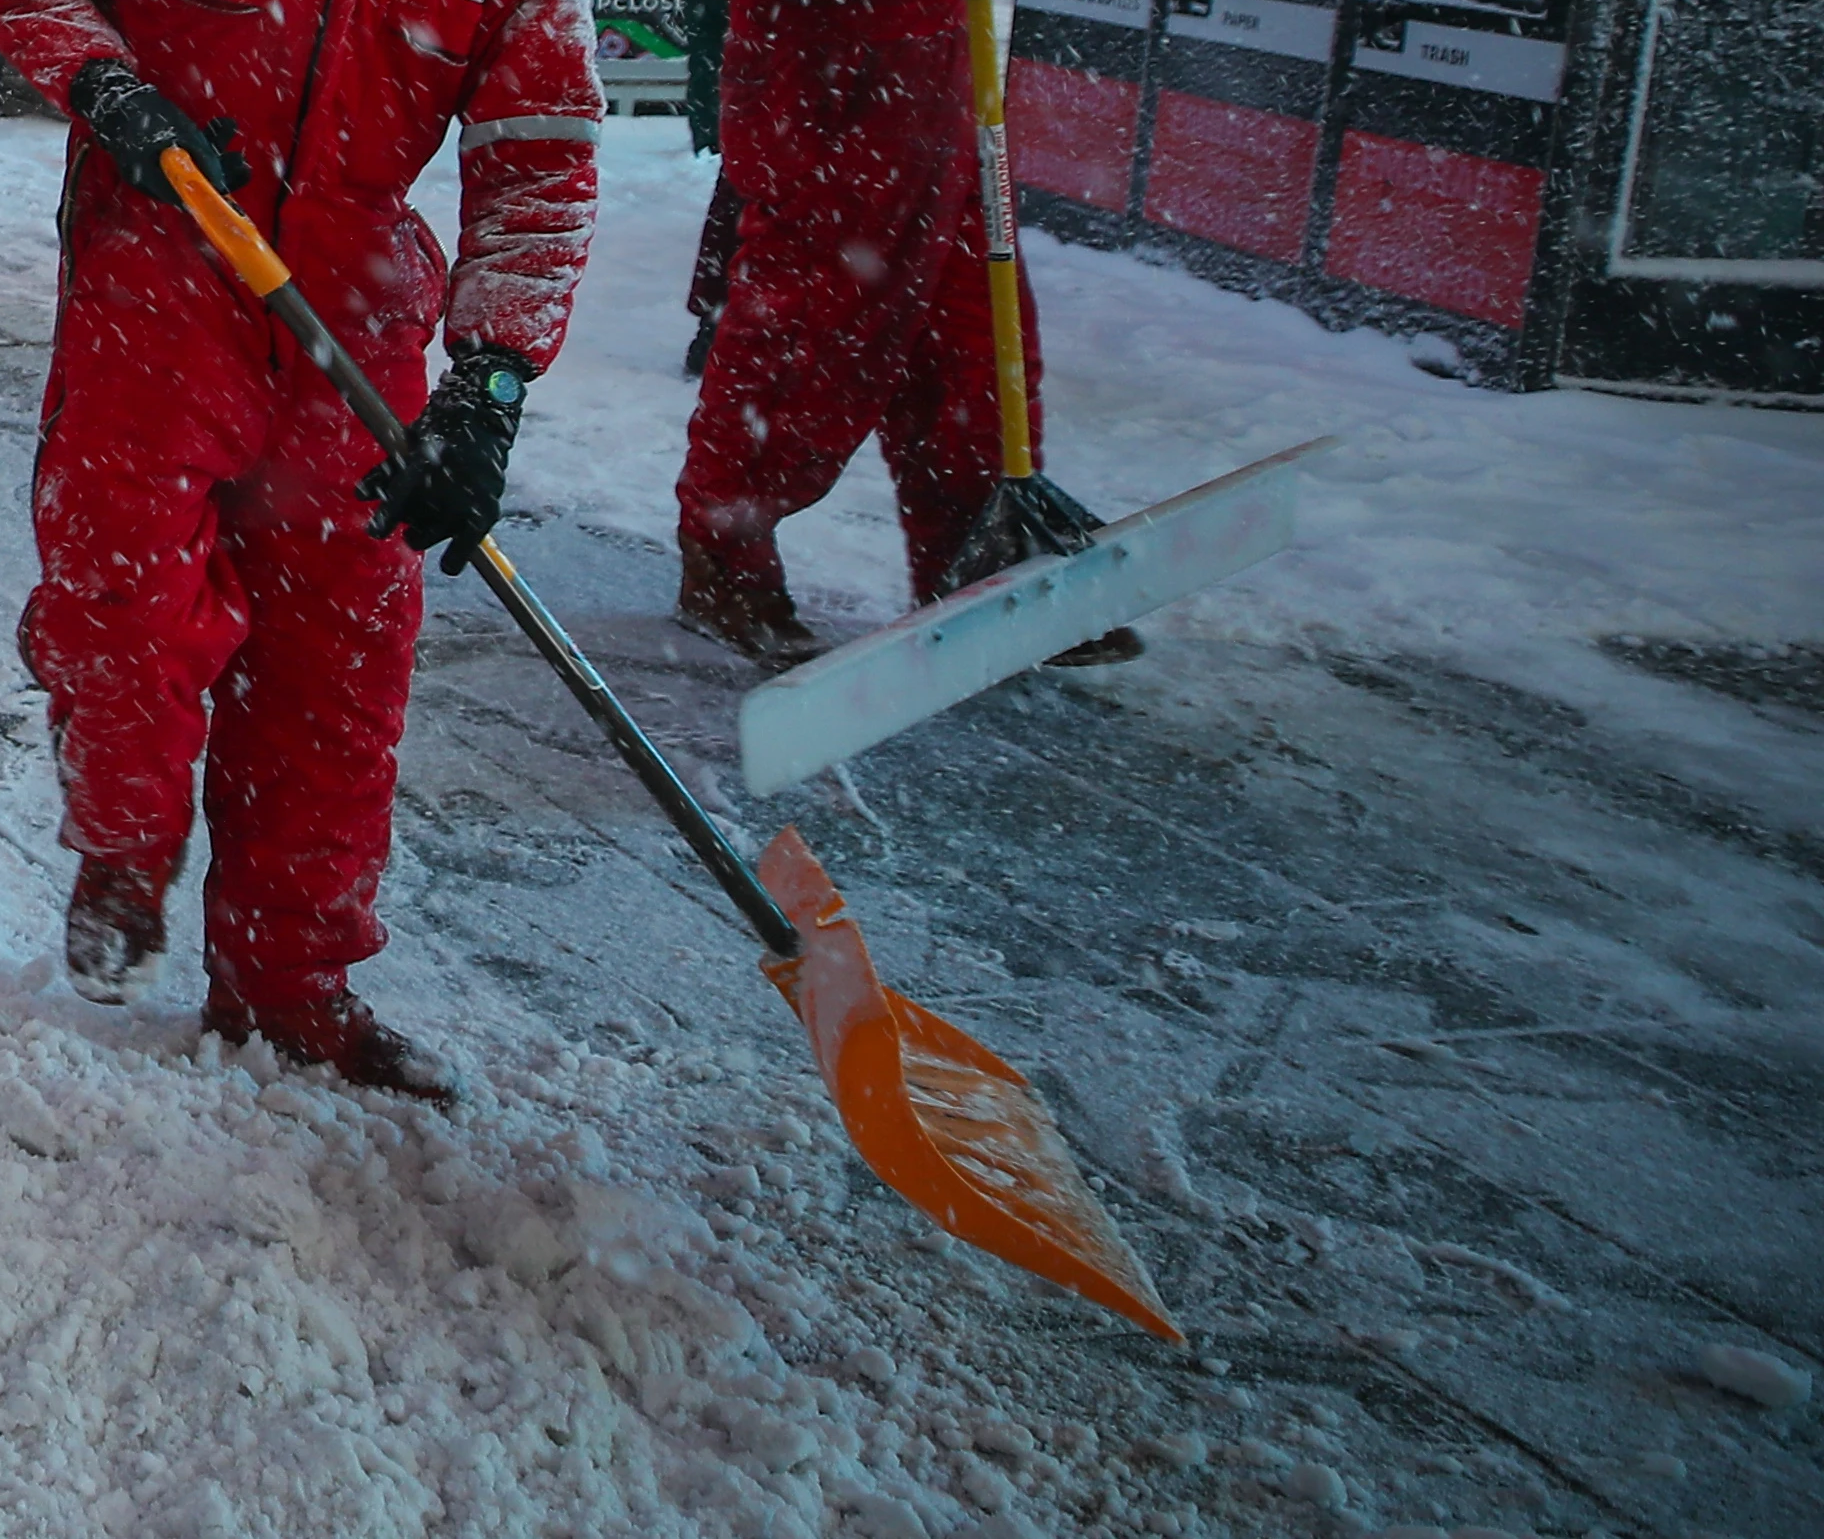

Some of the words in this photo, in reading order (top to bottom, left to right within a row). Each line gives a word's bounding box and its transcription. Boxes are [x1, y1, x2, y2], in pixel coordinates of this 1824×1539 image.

[1222, 10, 1261, 31] PAPER
[1420, 43, 1470, 67] TRASH
[996, 153, 1012, 197] SNOW
